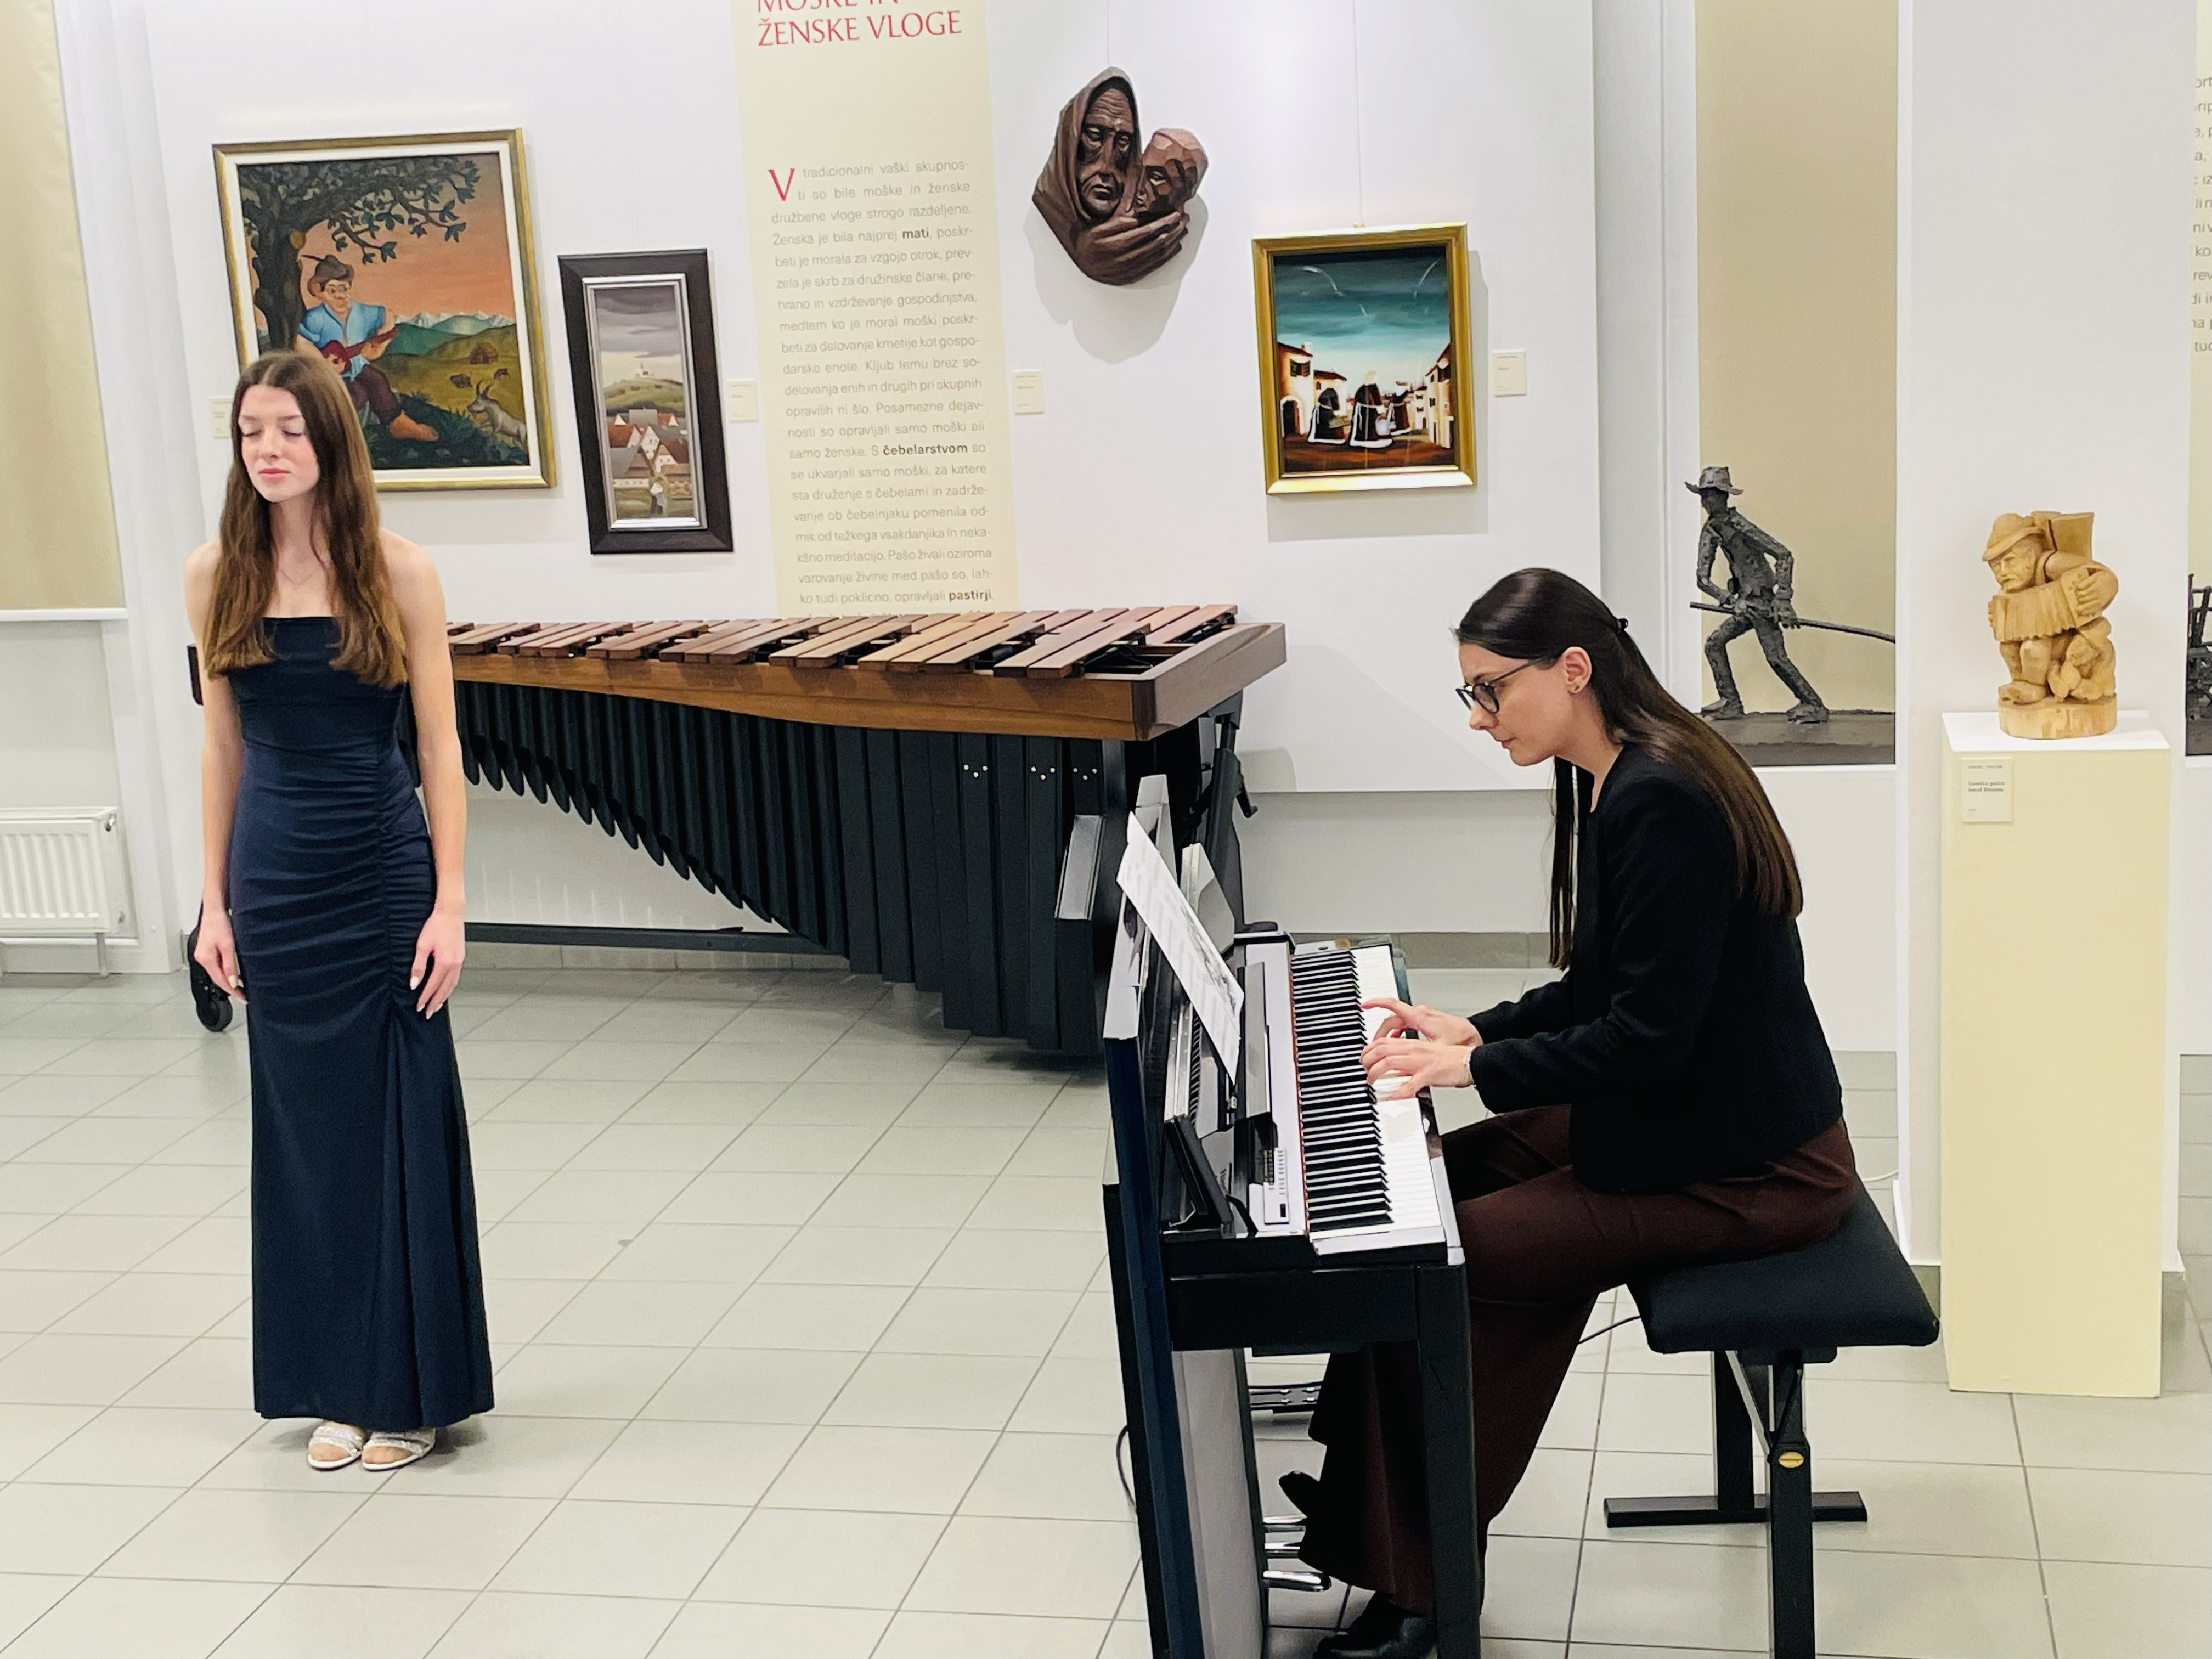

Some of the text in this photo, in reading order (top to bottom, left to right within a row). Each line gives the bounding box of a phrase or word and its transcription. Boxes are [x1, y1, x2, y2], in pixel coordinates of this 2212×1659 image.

[758, 10, 963, 47] ŽENSKE VLOGE
[768, 160, 969, 202] V tradicionalni vaški skupnos-
[797, 180, 970, 201] ti so bile moške in ženske
[770, 211, 826, 224] družbene
[830, 208, 862, 223] vloge
[866, 207, 905, 221] strogo
[772, 231, 814, 246] Ženska
[817, 232, 829, 246] je
[832, 230, 854, 243] bila
[857, 227, 898, 244] najprej
[935, 224, 973, 240] poskr-
[774, 256, 797, 268] beti
[798, 254, 810, 269] je
[811, 252, 852, 266] morala
[853, 253, 867, 264] za
[869, 249, 908, 265] vzgojo
[945, 249, 974, 262] prev-
[775, 277, 799, 289] zela
[800, 276, 812, 291] je
[814, 274, 840, 287] skrb
[840, 276, 855, 286] za
[856, 271, 913, 285] družinske
[951, 270, 976, 284] pre-
[777, 299, 810, 311] hrano
[813, 300, 825, 309] in
[827, 294, 893, 309] vzdrževanje
[779, 312, 979, 332] medtem ko je moral moški poskr-
[780, 335, 980, 353] beti za delovanje kmetije kot gospo-
[865, 358, 894, 374] Kljub
[898, 359, 928, 370] temu
[932, 356, 958, 369] brez
[962, 358, 981, 368] so-
[783, 382, 839, 397] delovanja
[839, 381, 866, 394] enih
[867, 381, 878, 392] in
[879, 379, 918, 394] drugih
[935, 376, 983, 392] skupnih
[785, 403, 833, 419] opravilih
[837, 404, 848, 415] ni
[875, 401, 944, 414] Posamezne
[947, 399, 984, 413] dejav-
[787, 419, 985, 439] nosti so opravljali samo moški ali
[788, 449, 821, 459] samo
[870, 444, 880, 456] S
[882, 442, 968, 456] čebelarstvom
[971, 443, 986, 453] so
[790, 470, 804, 481] se
[806, 466, 855, 481] ukvarjali
[857, 467, 891, 478] samo
[934, 465, 948, 476] za
[950, 463, 987, 475] katere
[791, 490, 810, 501] sta
[811, 488, 863, 502] druženje
[874, 486, 929, 499] čebelami
[931, 484, 943, 496] in
[945, 483, 989, 496] zadrže-
[793, 504, 990, 523] vanje ob čebelnjaku pomenila od-
[795, 526, 991, 544] mik od težkega vsakdanjika in neka-
[796, 552, 824, 563] kšno
[887, 548, 917, 561] Pašo
[917, 547, 945, 560] živali
[945, 548, 992, 560] oziroma
[797, 573, 853, 585] varovanje
[855, 570, 889, 583] živine
[891, 569, 918, 582] med
[919, 568, 949, 583] pašo
[971, 567, 994, 579] lah-
[799, 592, 814, 605] ko
[815, 591, 838, 604] tudi
[894, 589, 946, 604] opravljali
